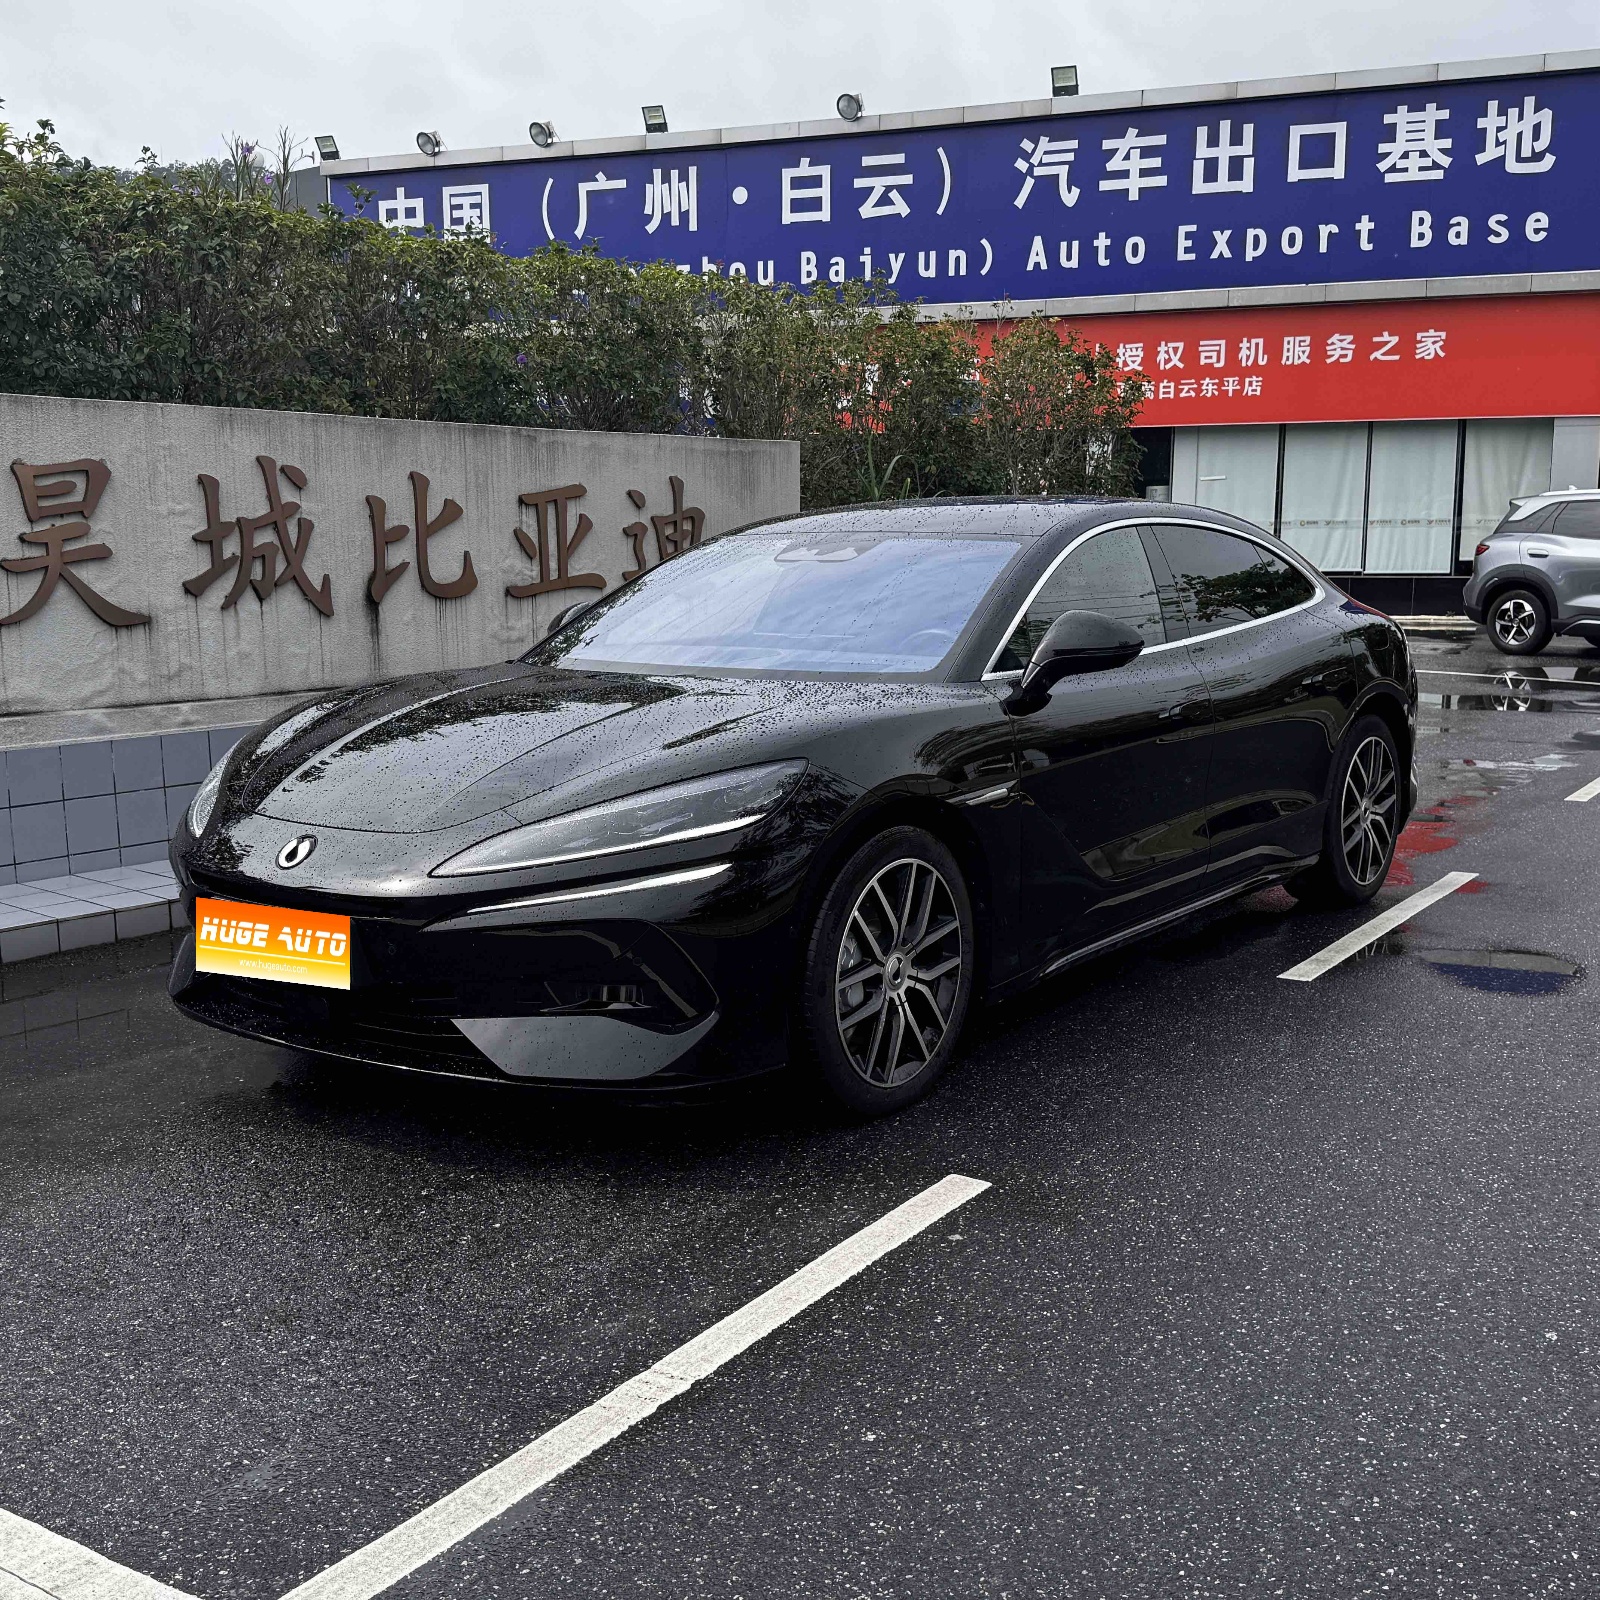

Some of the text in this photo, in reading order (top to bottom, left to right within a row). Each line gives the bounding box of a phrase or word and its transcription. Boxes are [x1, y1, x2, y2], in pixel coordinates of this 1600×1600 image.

[800, 238, 994, 285] Baiyun)
[1026, 231, 1146, 271] Auto
[1176, 214, 1376, 262] Export
[1410, 210, 1549, 248] Base
[1095, 328, 1447, 372] 授权司机服务之家
[0, 455, 706, 627] 昊城比亚迪
